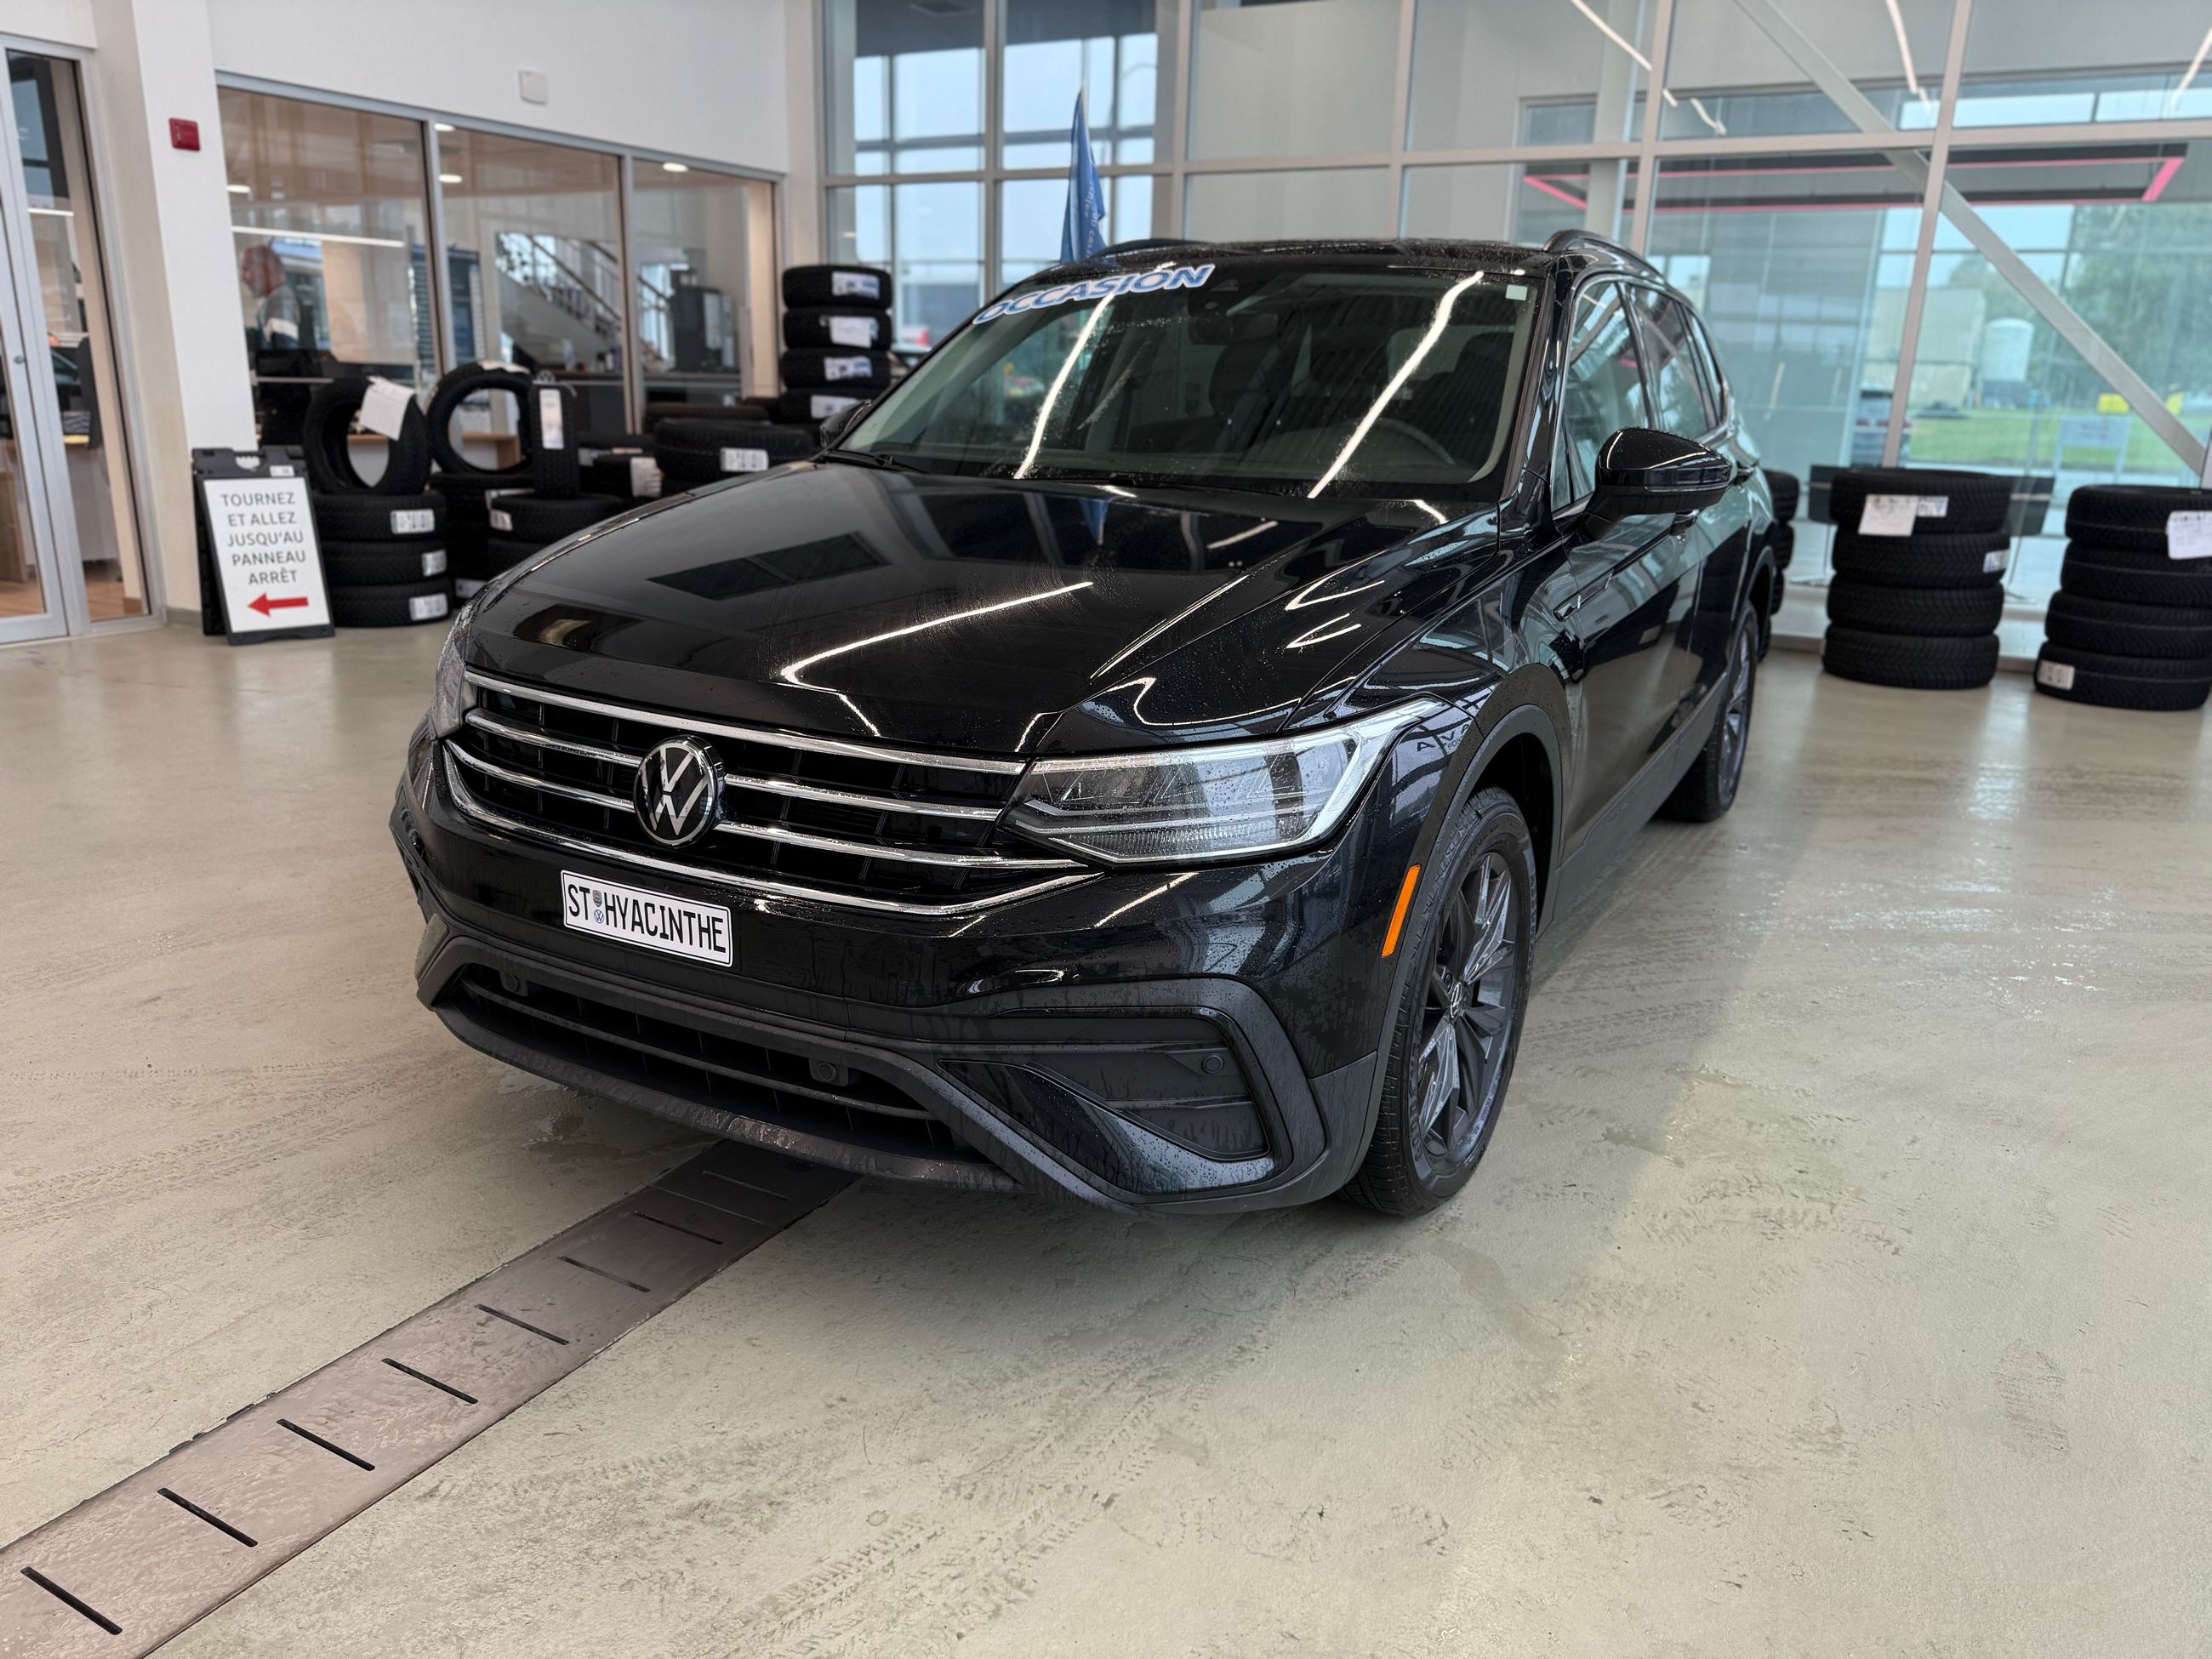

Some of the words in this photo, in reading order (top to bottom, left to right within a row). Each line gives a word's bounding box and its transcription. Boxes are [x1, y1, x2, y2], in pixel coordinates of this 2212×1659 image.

[972, 264, 1215, 324] OCCASION
[220, 492, 295, 507] TOURNEZ
[227, 514, 246, 527] ET
[250, 511, 297, 525] ALLEZ
[226, 531, 304, 547] JUSQU'AU
[231, 550, 306, 567] PANNEAU
[248, 567, 298, 585] ARRÊT
[567, 884, 590, 921] ST
[603, 892, 727, 954] HYACINTHE
